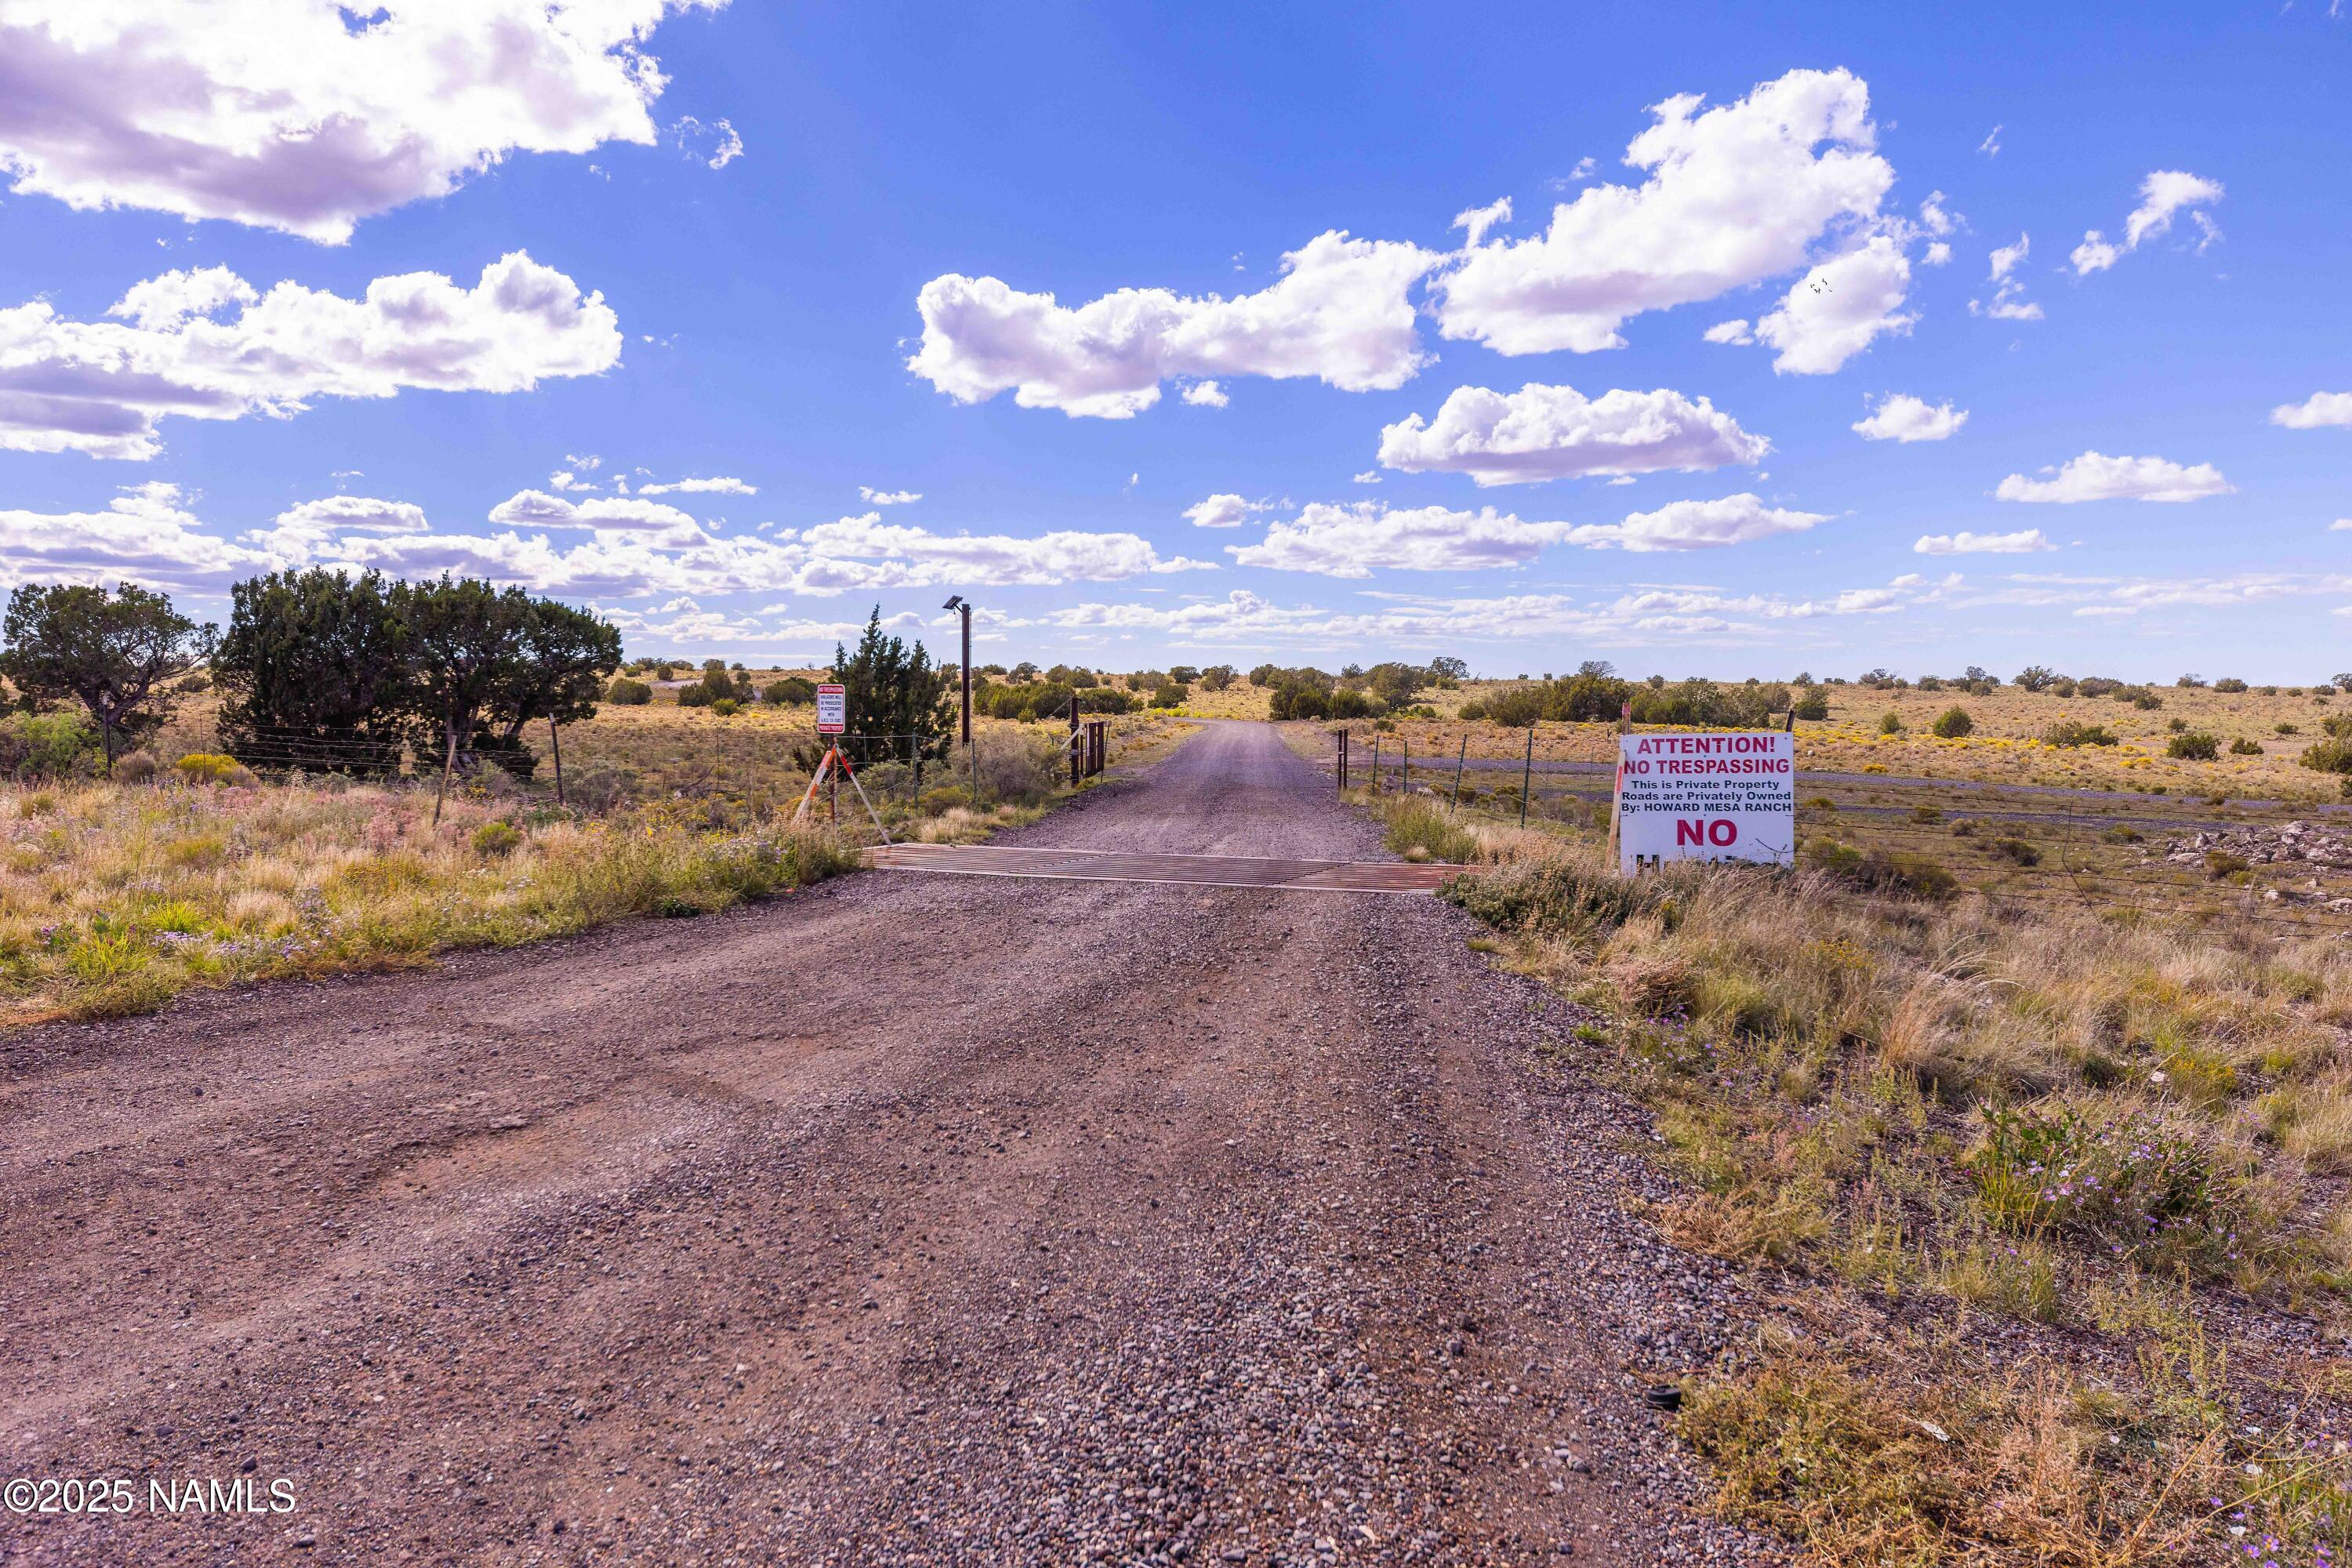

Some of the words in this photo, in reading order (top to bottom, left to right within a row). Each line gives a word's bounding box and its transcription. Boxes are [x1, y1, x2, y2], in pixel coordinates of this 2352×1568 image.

[1637, 736, 1775, 754] ATTENTION!
[1624, 760, 1650, 775] NO
[1656, 758, 1789, 774] TRESPASSING
[1632, 780, 1657, 789] This
[1661, 780, 1672, 789] is
[1676, 780, 1720, 789] Private
[1724, 780, 1780, 790] Property
[1622, 792, 1659, 800] Roads
[1687, 792, 1743, 802] Privately
[1747, 792, 1791, 800] Owned
[1621, 804, 1640, 813] By:
[1644, 803, 1700, 811] HOWARD
[1704, 803, 1740, 811] MESA
[1744, 803, 1791, 811] RANCH
[1676, 818, 1737, 847] NO
